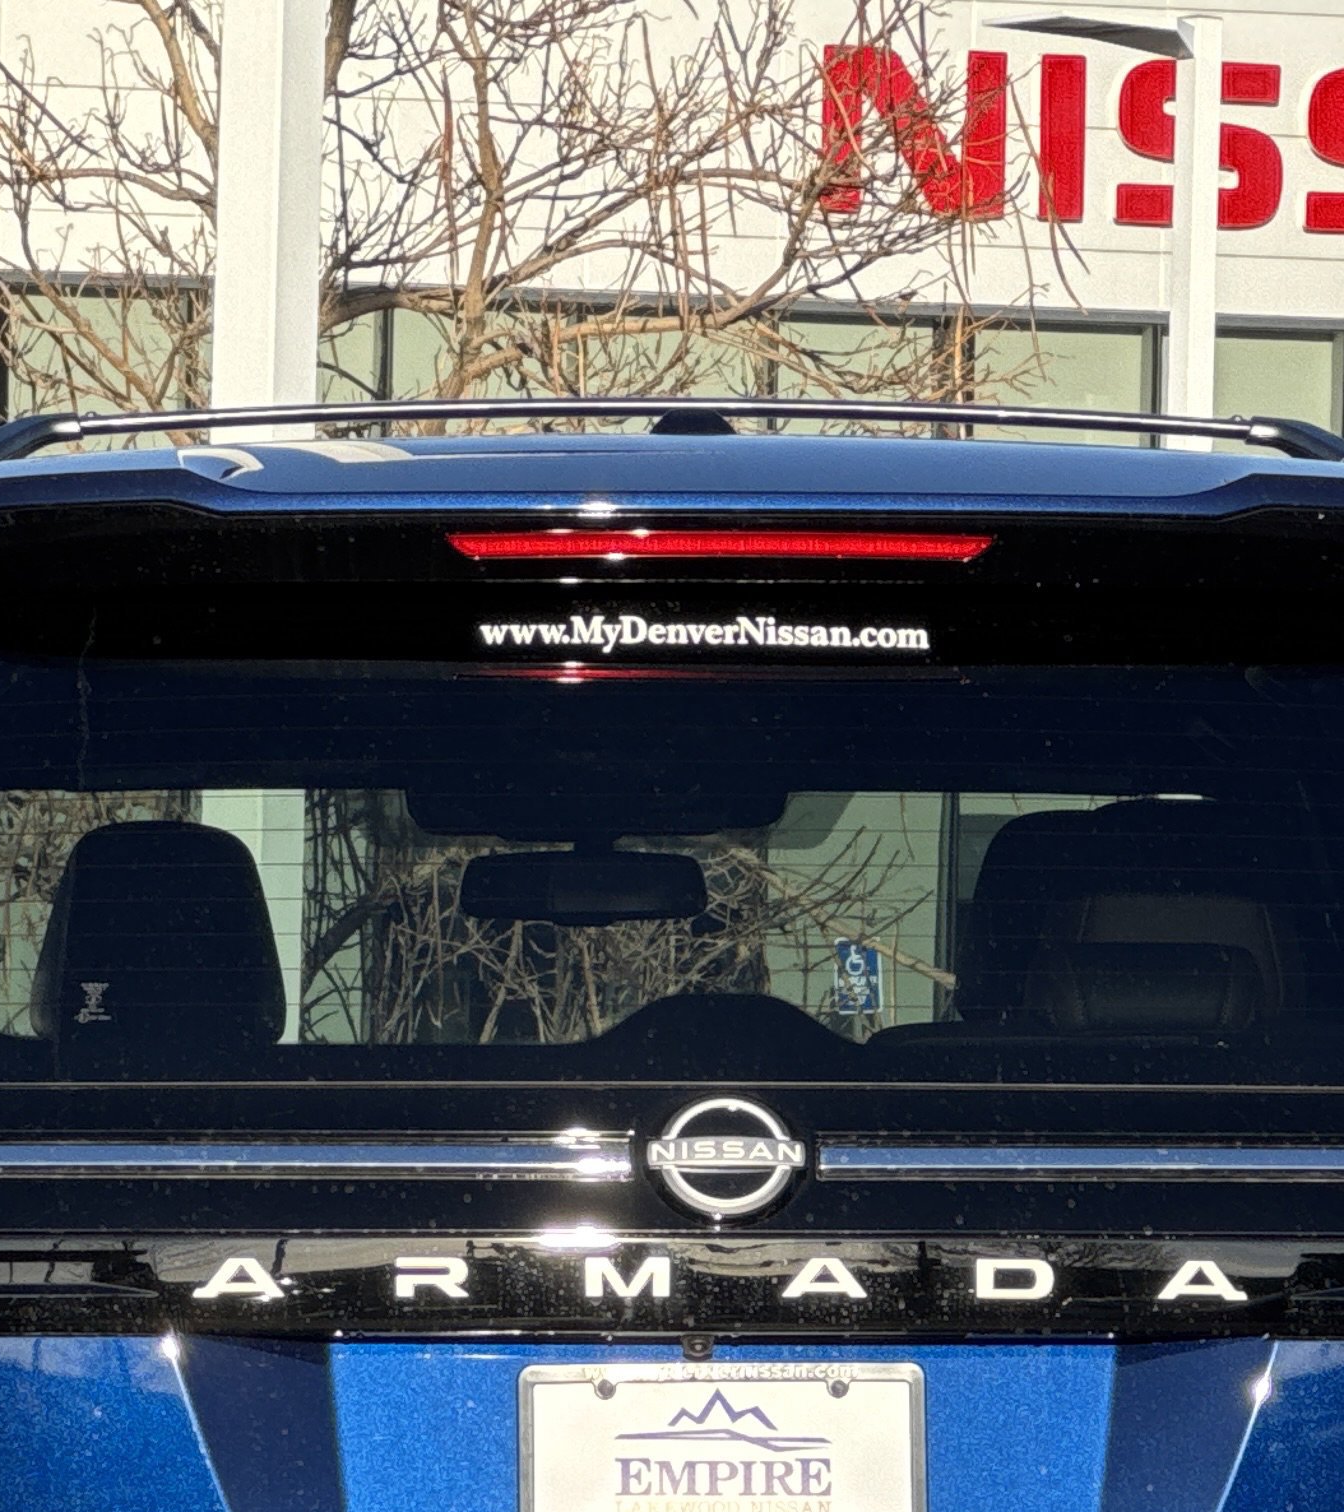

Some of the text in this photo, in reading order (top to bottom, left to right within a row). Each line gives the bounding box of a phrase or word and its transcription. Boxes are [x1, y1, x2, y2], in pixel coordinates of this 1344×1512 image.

[480, 615, 930, 652] www.MyDenverNissan.com
[650, 1140, 802, 1163] NISSAN
[192, 1256, 1249, 1300] ARMADA
[614, 1457, 832, 1496] EMPIRE
